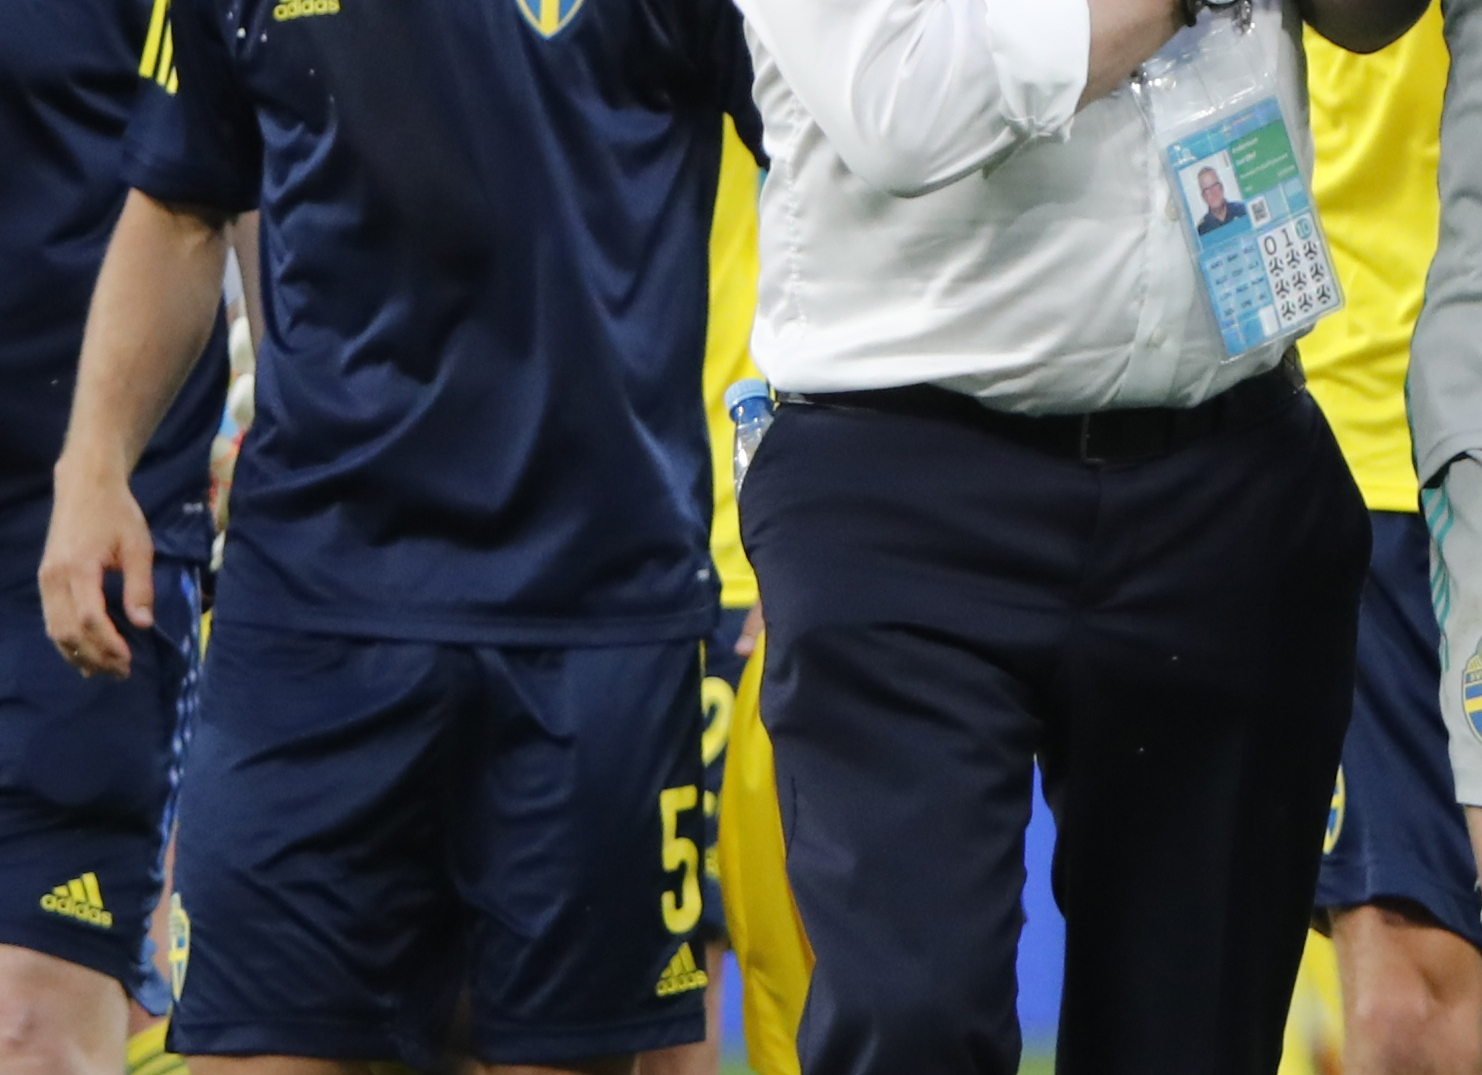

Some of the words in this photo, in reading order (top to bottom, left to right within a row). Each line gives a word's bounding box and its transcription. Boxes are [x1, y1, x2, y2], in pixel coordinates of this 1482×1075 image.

[659, 783, 703, 934] 5
[40, 893, 113, 929] adidas
[655, 969, 709, 997] adidas
